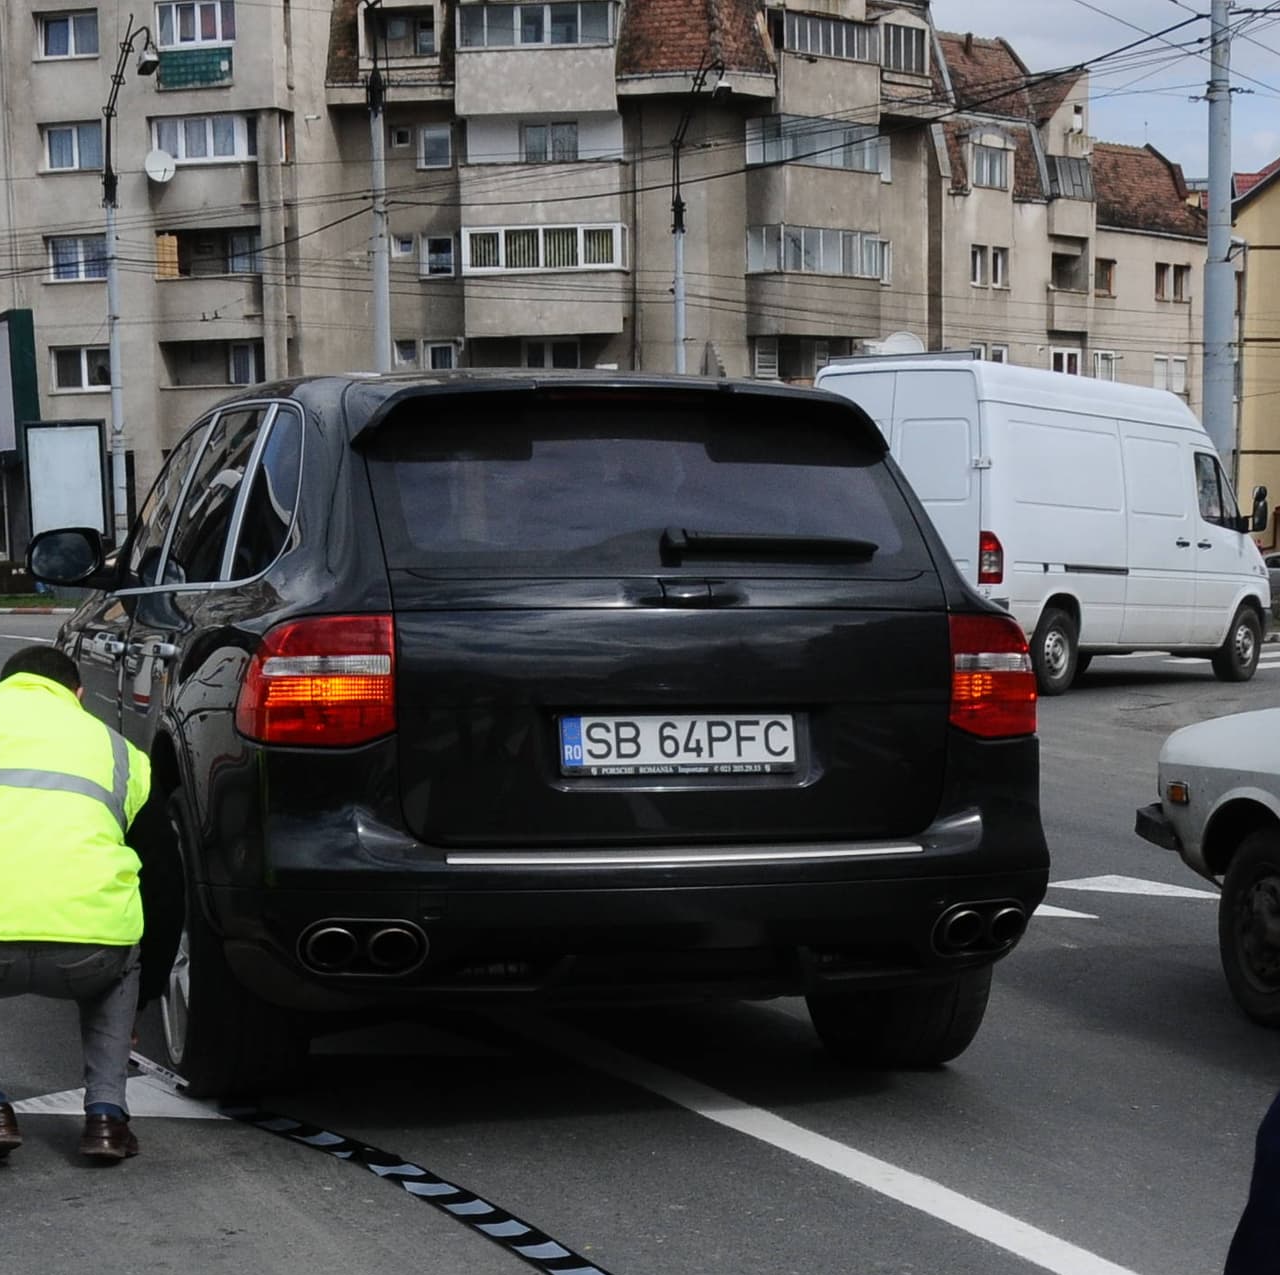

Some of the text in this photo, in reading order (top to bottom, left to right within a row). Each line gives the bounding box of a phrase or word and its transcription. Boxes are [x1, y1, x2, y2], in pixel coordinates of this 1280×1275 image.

[565, 744, 582, 759] RO
[586, 719, 789, 759] SB 64PFC
